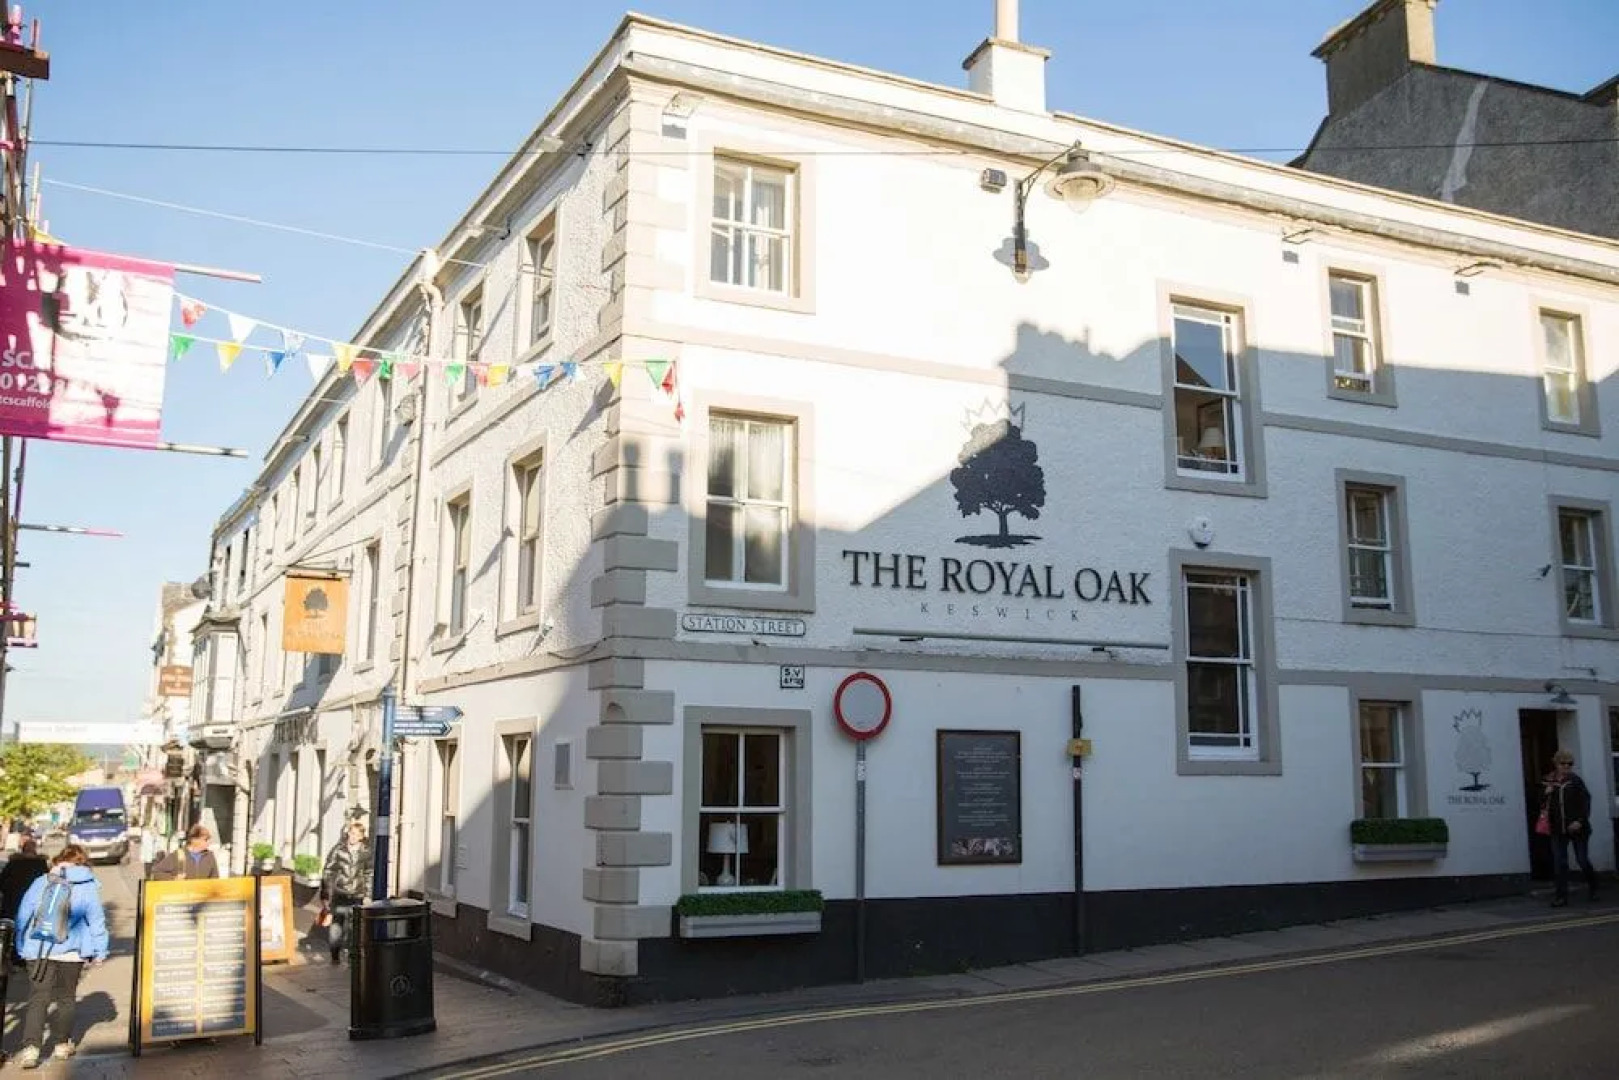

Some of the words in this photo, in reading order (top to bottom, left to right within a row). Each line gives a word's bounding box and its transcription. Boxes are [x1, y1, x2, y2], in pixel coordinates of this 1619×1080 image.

[842, 549, 927, 589] THE
[940, 557, 1064, 599] ROYAL
[1074, 567, 1152, 605] OAK
[920, 602, 1079, 621] KESWICK
[688, 617, 746, 631] STATION
[752, 619, 799, 634] STREET
